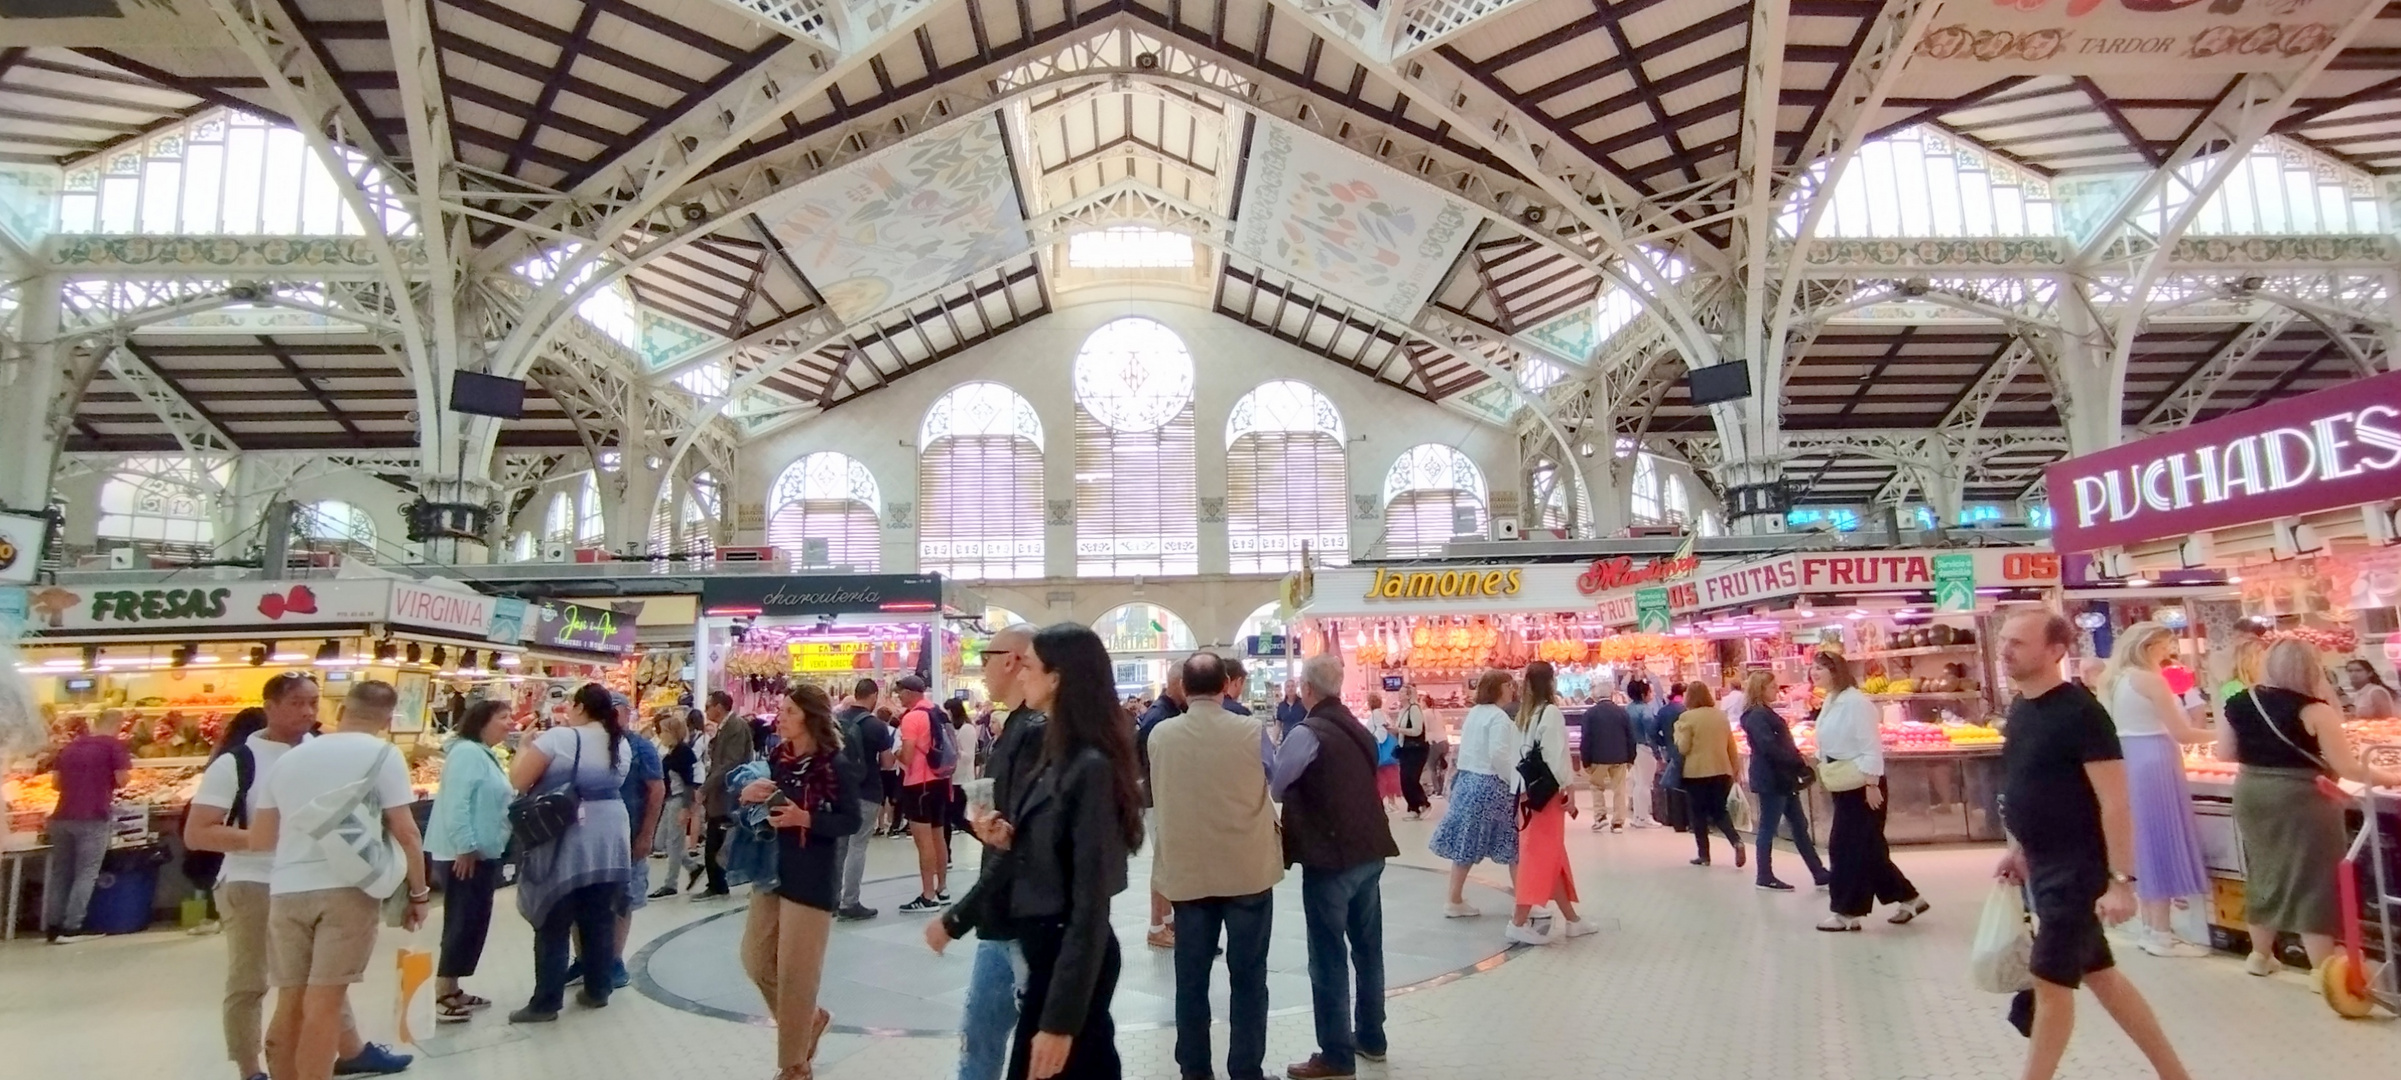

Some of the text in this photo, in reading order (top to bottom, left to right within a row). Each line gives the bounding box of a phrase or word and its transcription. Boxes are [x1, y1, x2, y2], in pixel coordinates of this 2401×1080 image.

[2077, 36, 2176, 55] TARDOR
[2073, 405, 2401, 529] PUCHADES
[1803, 556, 1936, 585] FRUTA
[2003, 552, 2059, 580] OS
[1363, 566, 1522, 599] Jamones
[1707, 560, 1797, 601] FRUTAS
[92, 587, 232, 623] FRESAS
[396, 588, 483, 628] VIRGINIA
[762, 584, 881, 606] charcutería
[1598, 595, 1638, 621] FRUT
[1669, 581, 1700, 609] OS
[810, 660, 828, 669] VENTA
